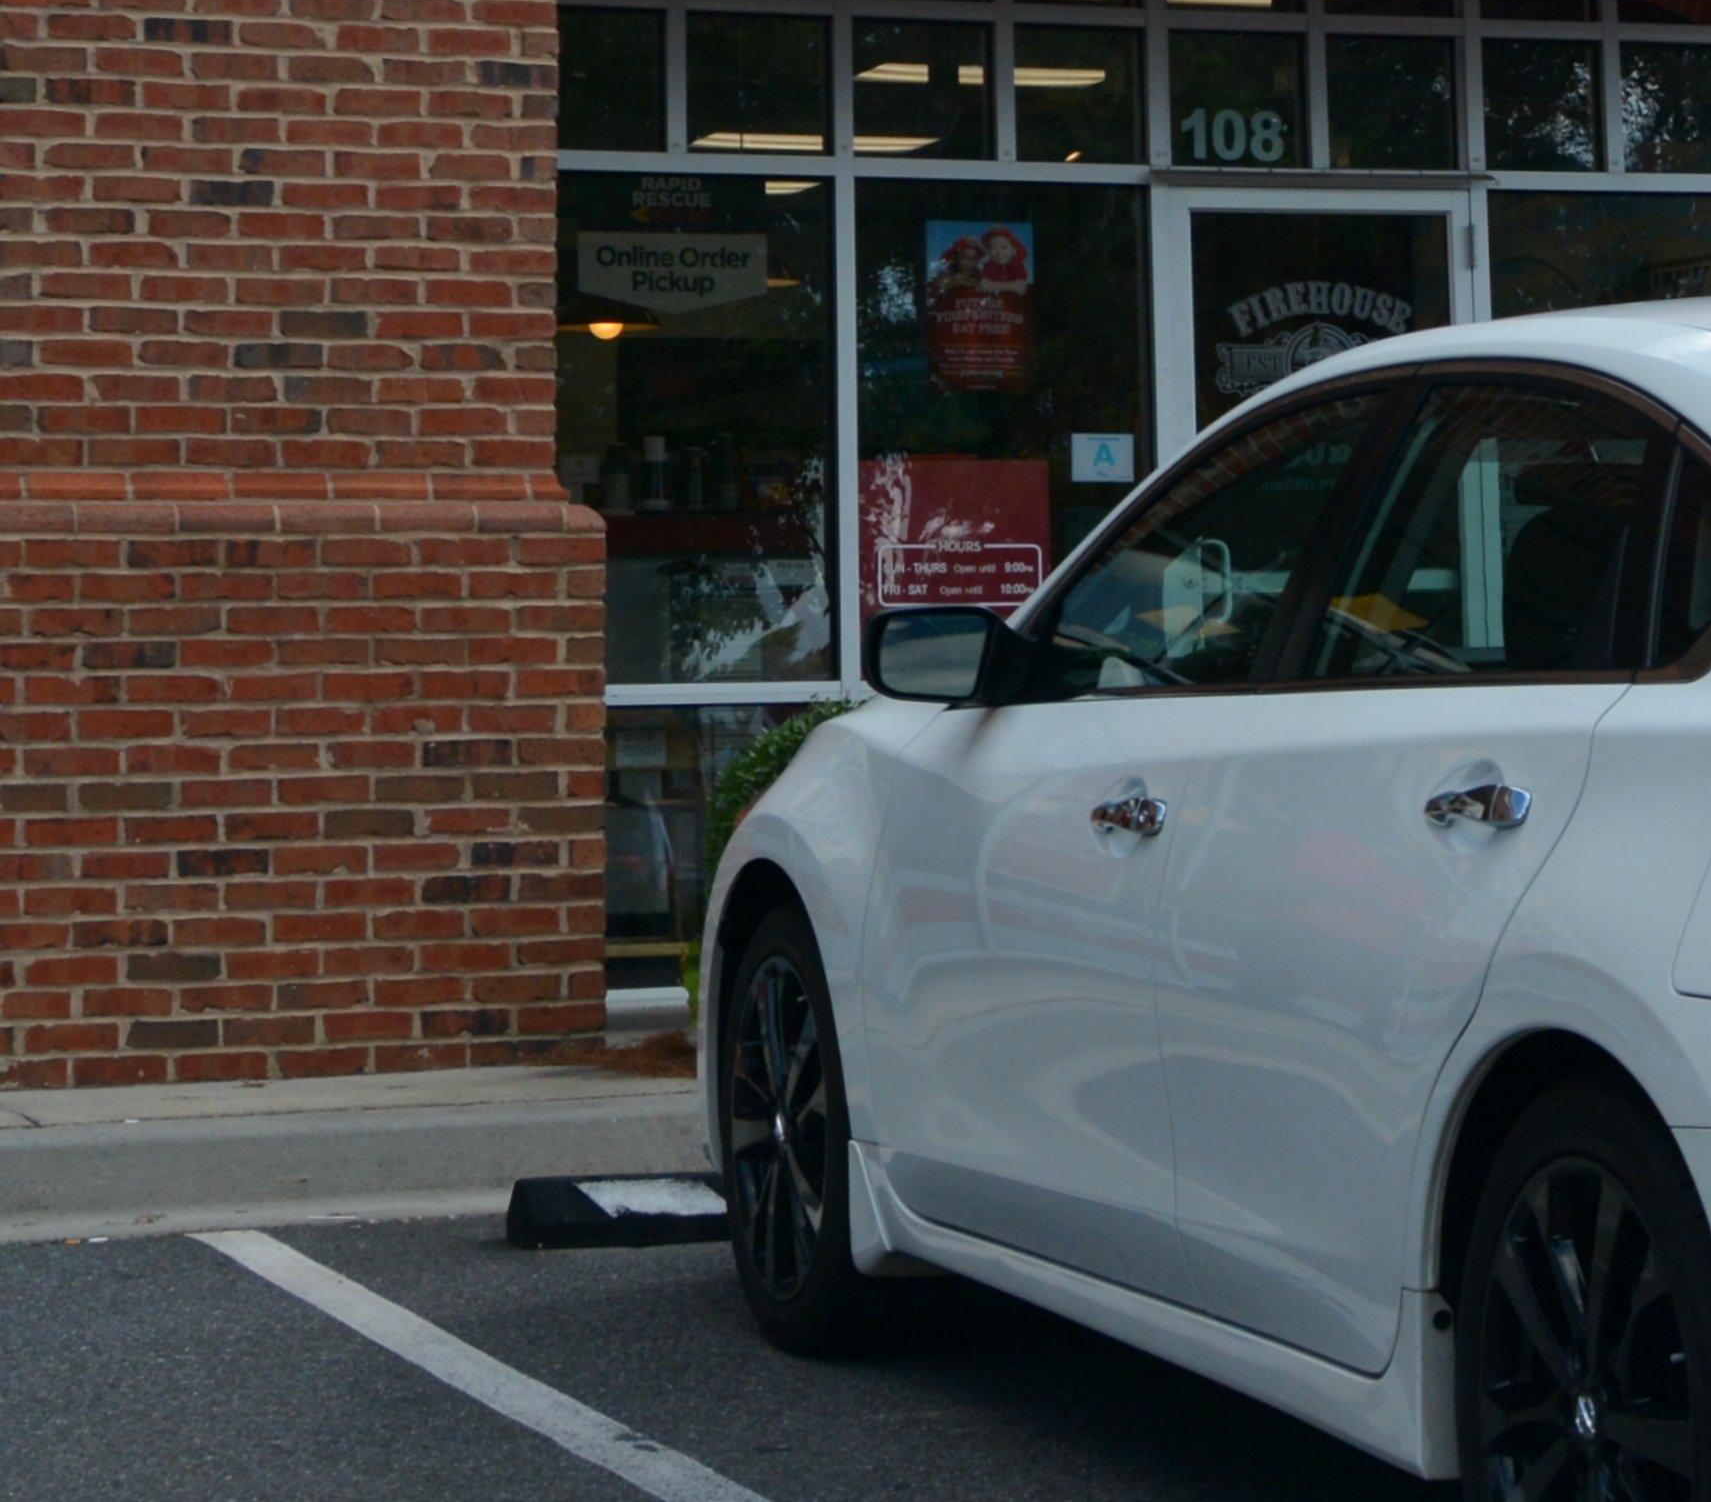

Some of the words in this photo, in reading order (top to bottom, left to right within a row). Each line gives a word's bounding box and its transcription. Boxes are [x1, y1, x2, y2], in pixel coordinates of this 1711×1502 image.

[1181, 107, 1285, 162] 108
[641, 177, 702, 191] RAPID
[632, 191, 711, 207] RESCUE
[596, 245, 674, 268] Online
[679, 246, 751, 268] Order
[632, 271, 715, 296] Pickup
[1228, 280, 1414, 337] FIREHOUSE
[1093, 443, 1115, 466] A
[938, 541, 982, 553] HOURS
[883, 562, 905, 574] SUN
[913, 562, 948, 574] THURS
[953, 564, 976, 576] Open
[978, 563, 996, 573] until
[883, 584, 900, 595] FRI
[907, 584, 928, 595] SAT
[939, 585, 962, 597] Open
[964, 584, 983, 595] until
